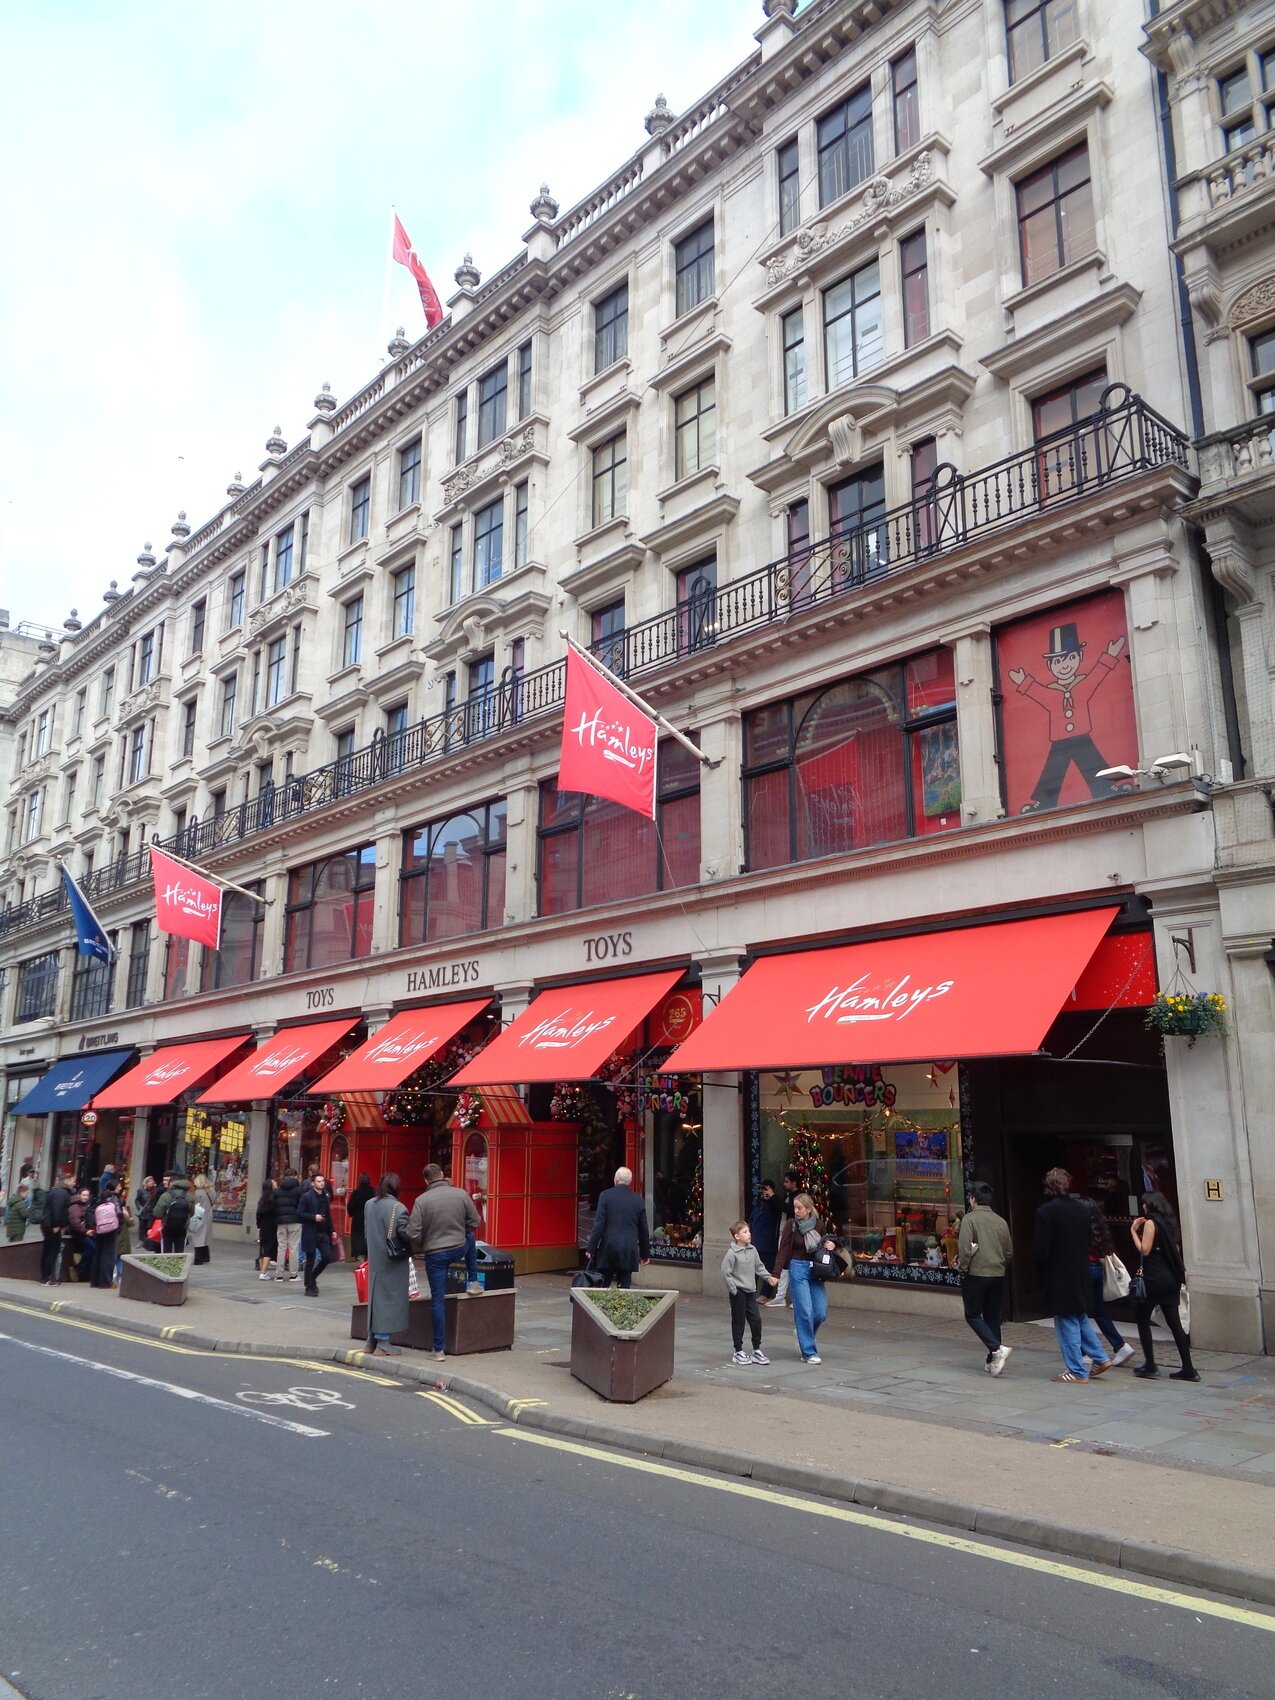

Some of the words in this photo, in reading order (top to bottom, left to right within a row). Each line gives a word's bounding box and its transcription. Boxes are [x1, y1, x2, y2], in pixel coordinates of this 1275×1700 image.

[570, 706, 653, 774] Hamleys
[161, 881, 217, 920] Hamleys
[583, 931, 633, 962] TOYS
[407, 960, 479, 992] HAMLEYS
[306, 988, 334, 1009] TOYS
[805, 972, 954, 1023] Hamleys
[86, 1032, 119, 1049] BREITLING
[518, 1008, 616, 1048] Hamleys
[248, 1044, 310, 1076] Hamleys
[363, 1028, 439, 1063] Hamleys
[809, 1080, 896, 1108] BOUNCERS
[1206, 1181, 1221, 1198] H
